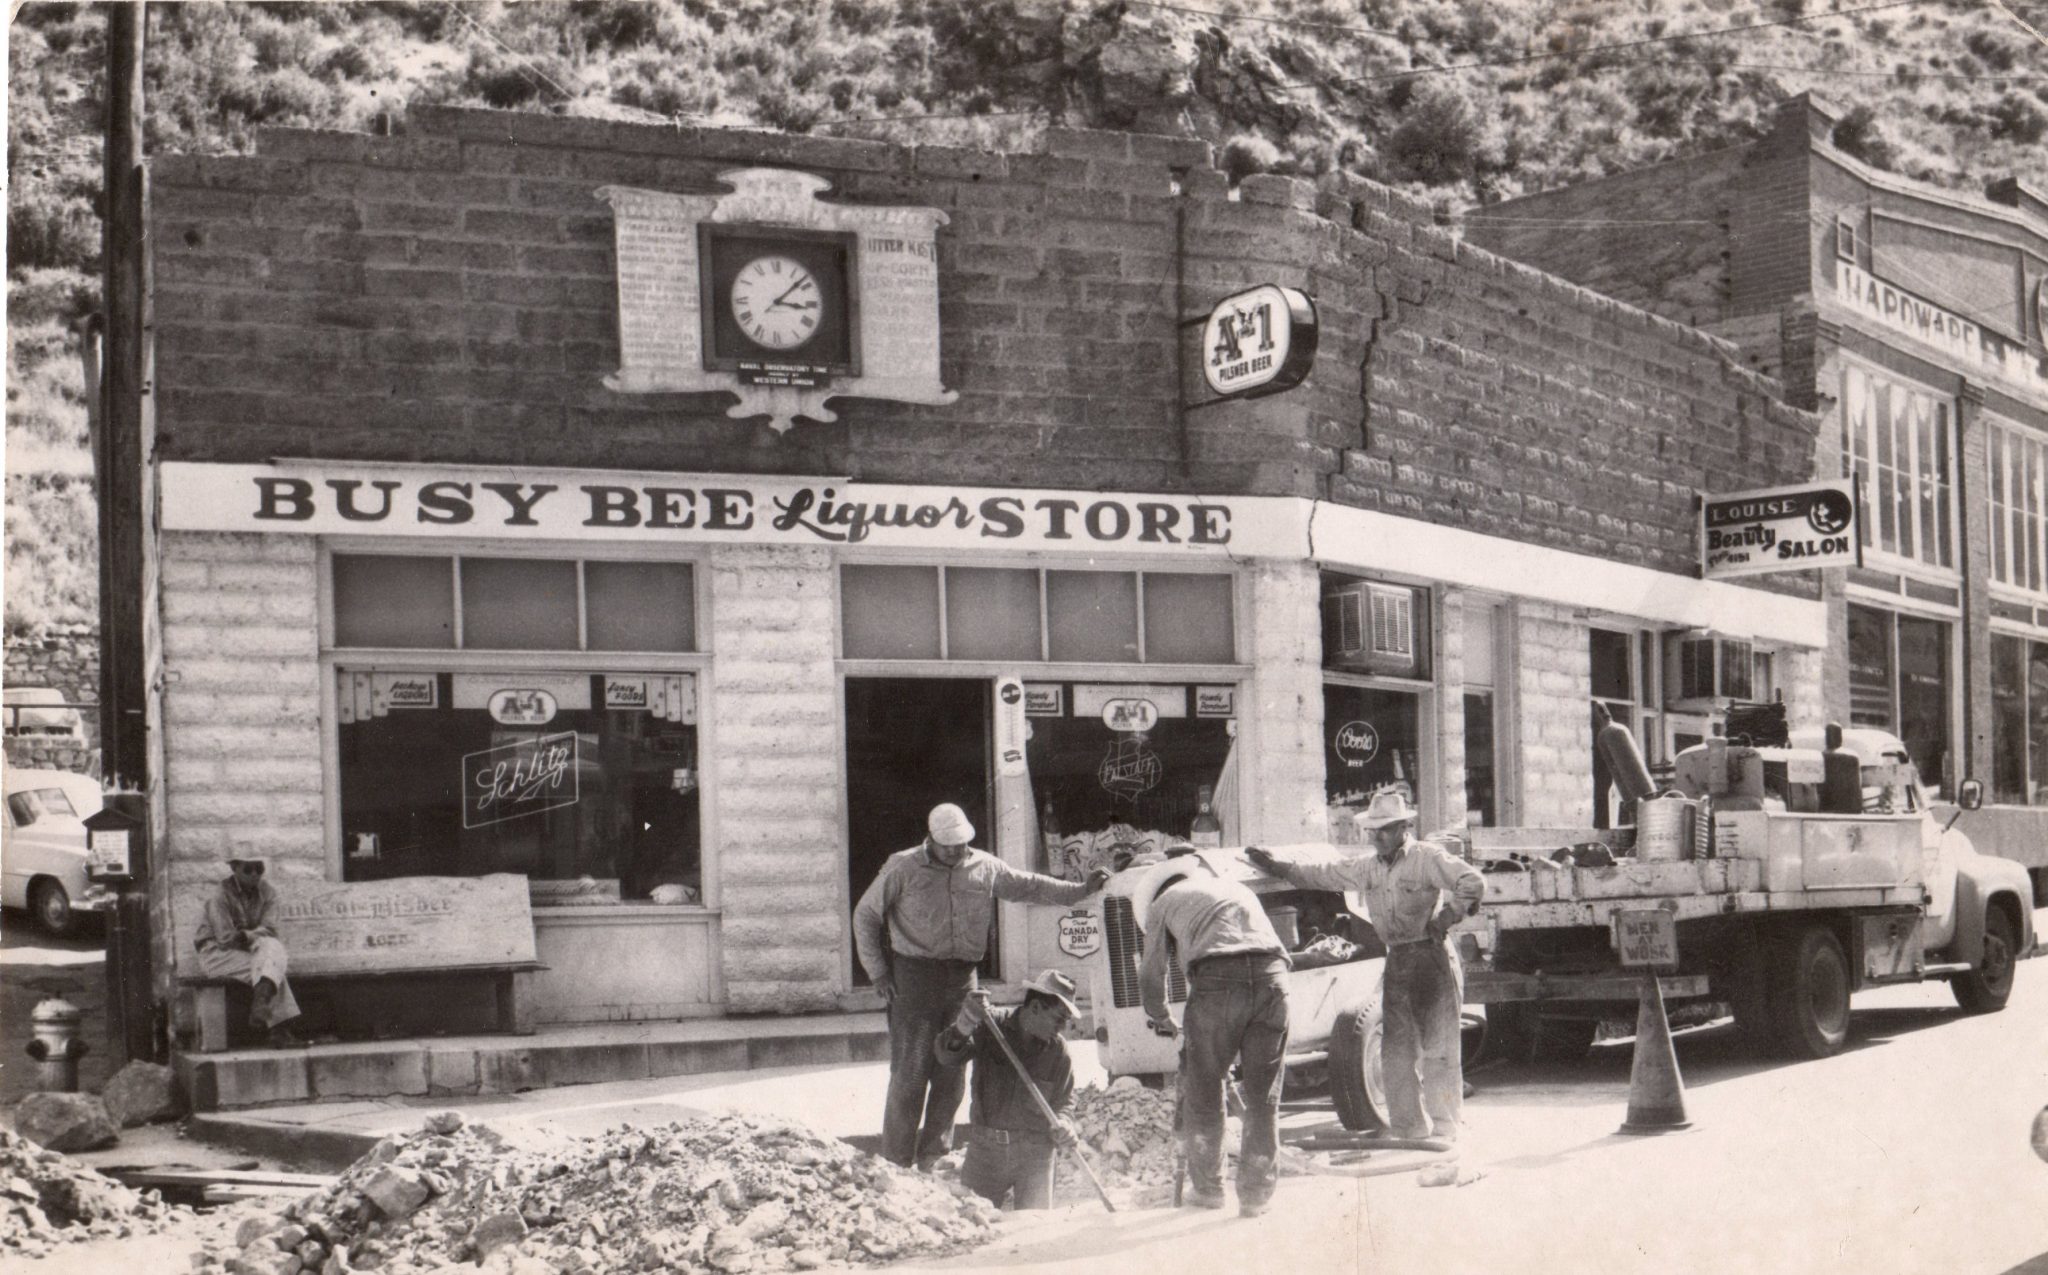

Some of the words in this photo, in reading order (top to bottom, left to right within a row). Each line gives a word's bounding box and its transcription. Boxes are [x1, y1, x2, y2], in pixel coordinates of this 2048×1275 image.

[1219, 361, 1250, 382] PILSNER
[1251, 354, 1273, 373] BEER
[753, 377, 788, 385] WESTERN
[252, 476, 559, 527] BUSY
[581, 484, 755, 531] BEE
[772, 487, 974, 544] Liquor
[980, 497, 1233, 545] STORE
[1713, 499, 1797, 522] LOUISE
[1708, 522, 1776, 551] Beauty
[1778, 536, 1849, 560] SALON
[1342, 728, 1373, 750] Coors
[476, 745, 568, 809] Schlitz
[1062, 926, 1098, 936] CANADA
[1625, 921, 1660, 936] MEN
[1071, 935, 1089, 944] DRY
[1639, 935, 1653, 945] AT
[1624, 943, 1671, 961] WORK
